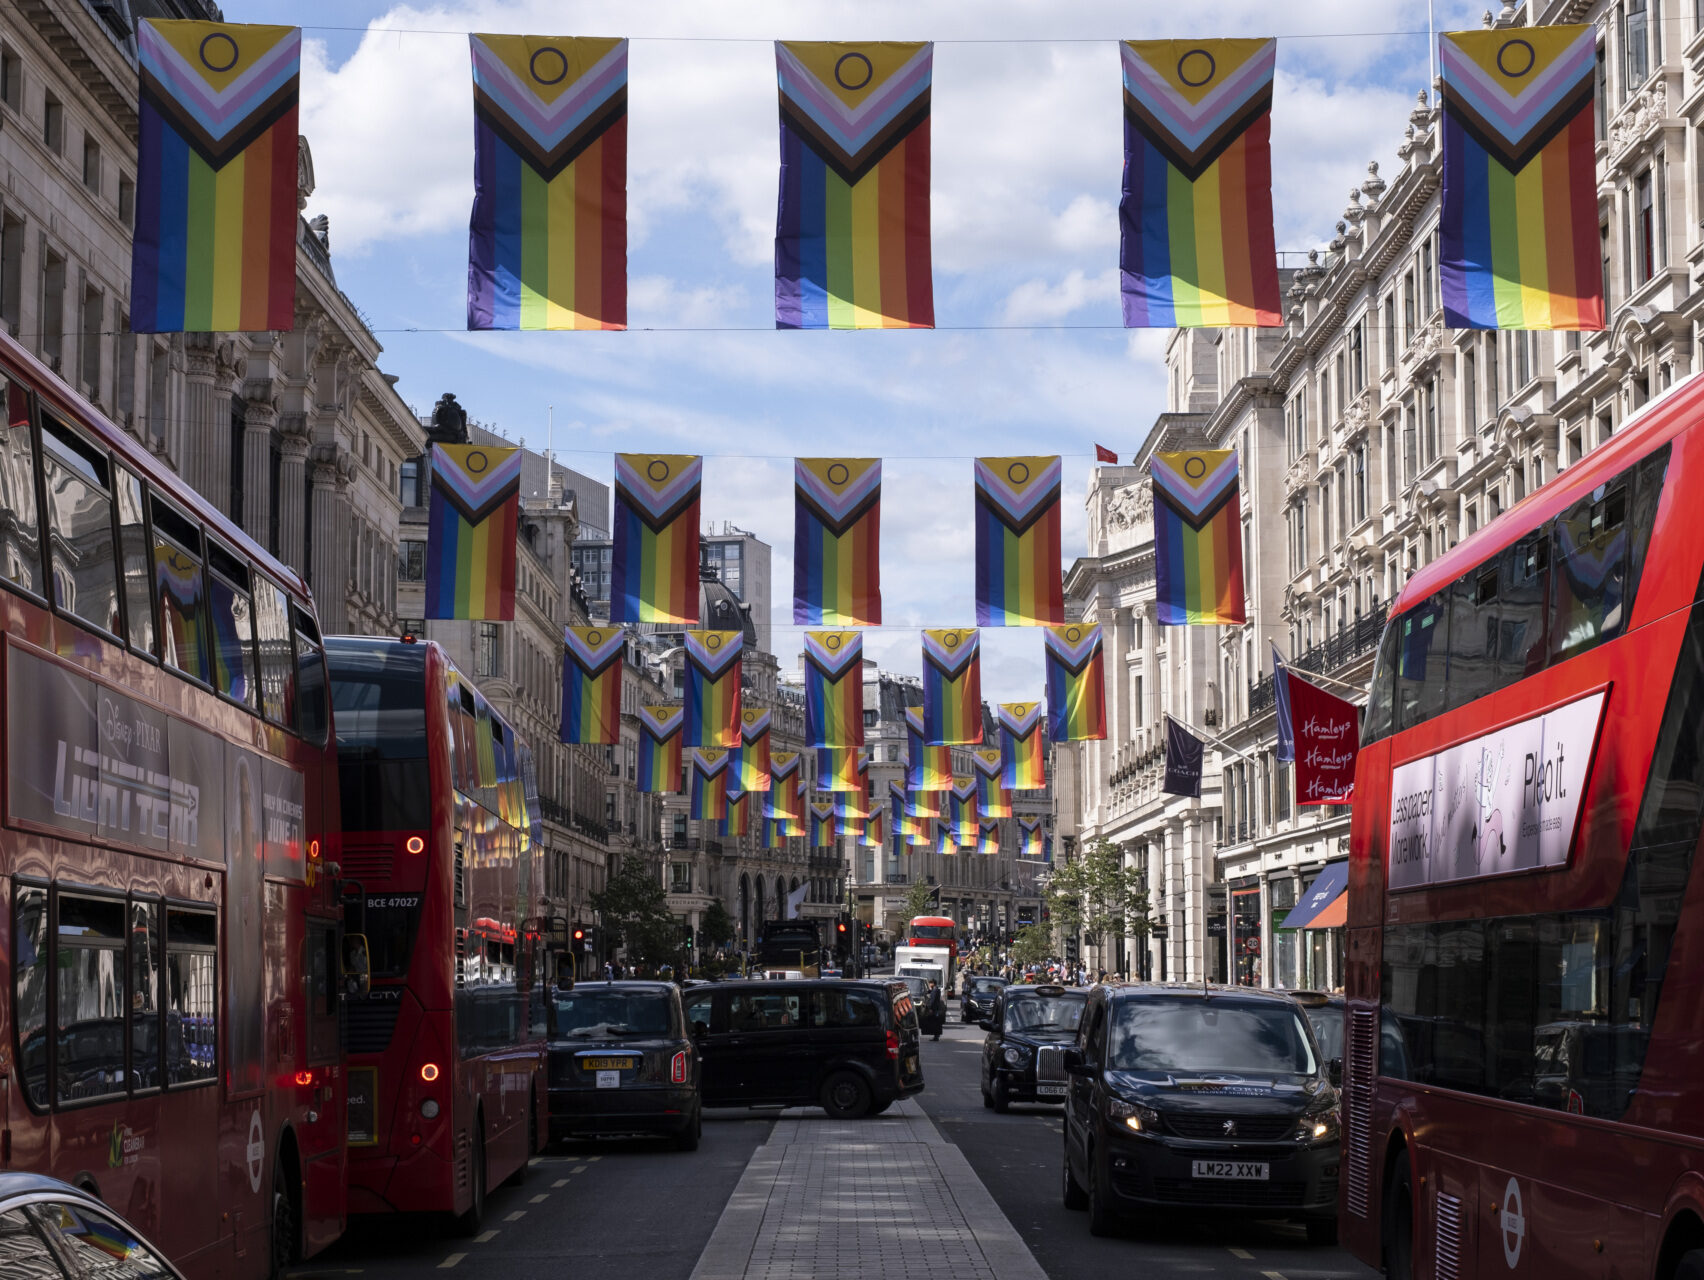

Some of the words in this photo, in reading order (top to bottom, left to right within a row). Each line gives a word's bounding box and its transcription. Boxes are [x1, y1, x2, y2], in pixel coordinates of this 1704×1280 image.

[136, 719, 162, 756] PIXAR
[1301, 715, 1351, 740] Hamleys
[1304, 745, 1353, 770] Hamleys
[1306, 775, 1354, 801] Hamleys
[1523, 751, 1553, 809] Pleo
[1555, 741, 1567, 800] it.
[1392, 793, 1407, 826] Less
[267, 817, 290, 847] JUNE
[1392, 830, 1408, 865] More
[367, 898, 387, 908] BCE
[388, 897, 418, 907] 47027
[1197, 1162, 1233, 1176] LM22
[1237, 1163, 1262, 1177] XXW
